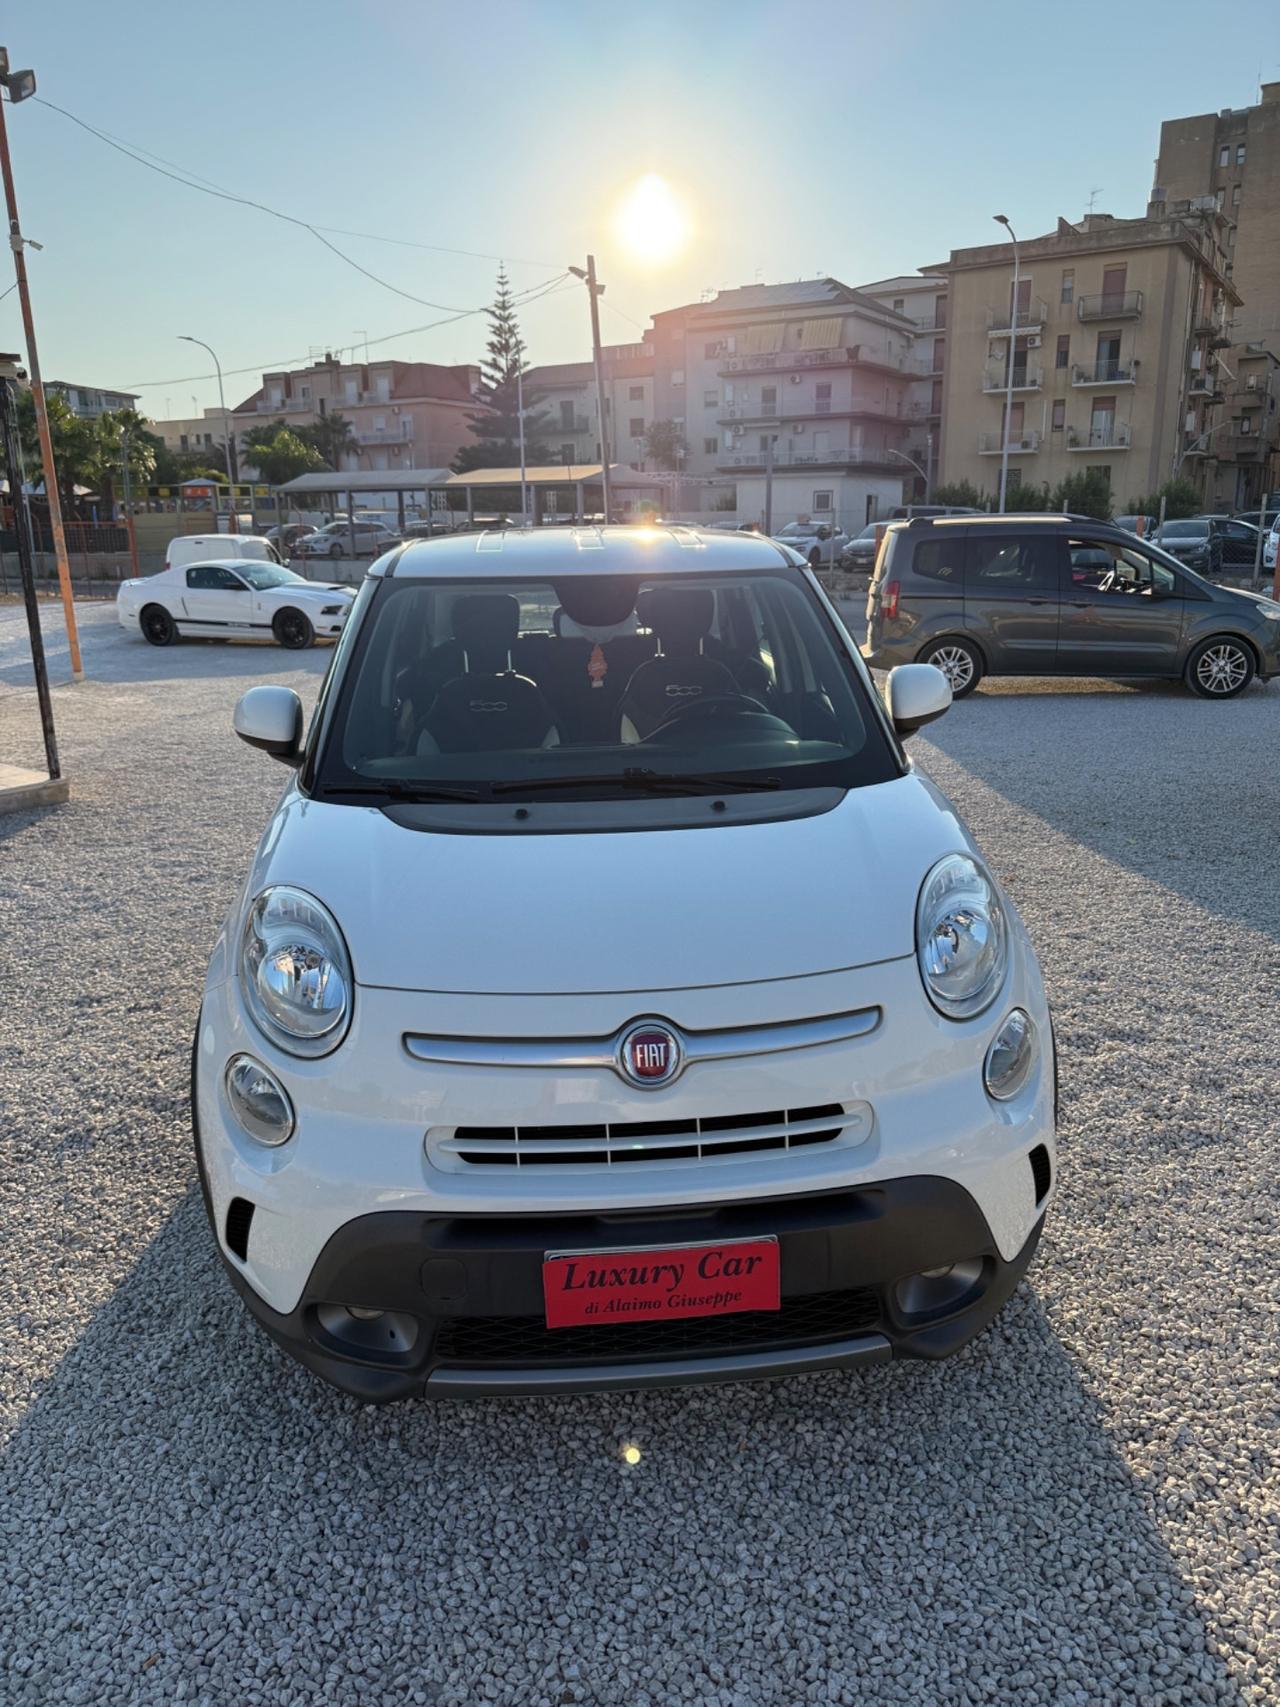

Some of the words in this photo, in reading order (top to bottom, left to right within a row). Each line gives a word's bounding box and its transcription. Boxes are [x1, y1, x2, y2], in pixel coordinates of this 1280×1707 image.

[636, 1043, 666, 1068] FIAT
[562, 1263, 684, 1292] Luxury
[698, 1251, 763, 1279] Car
[585, 1302, 599, 1314] di
[603, 1297, 661, 1313] Alaimo
[667, 1291, 742, 1309] Giuseppe
